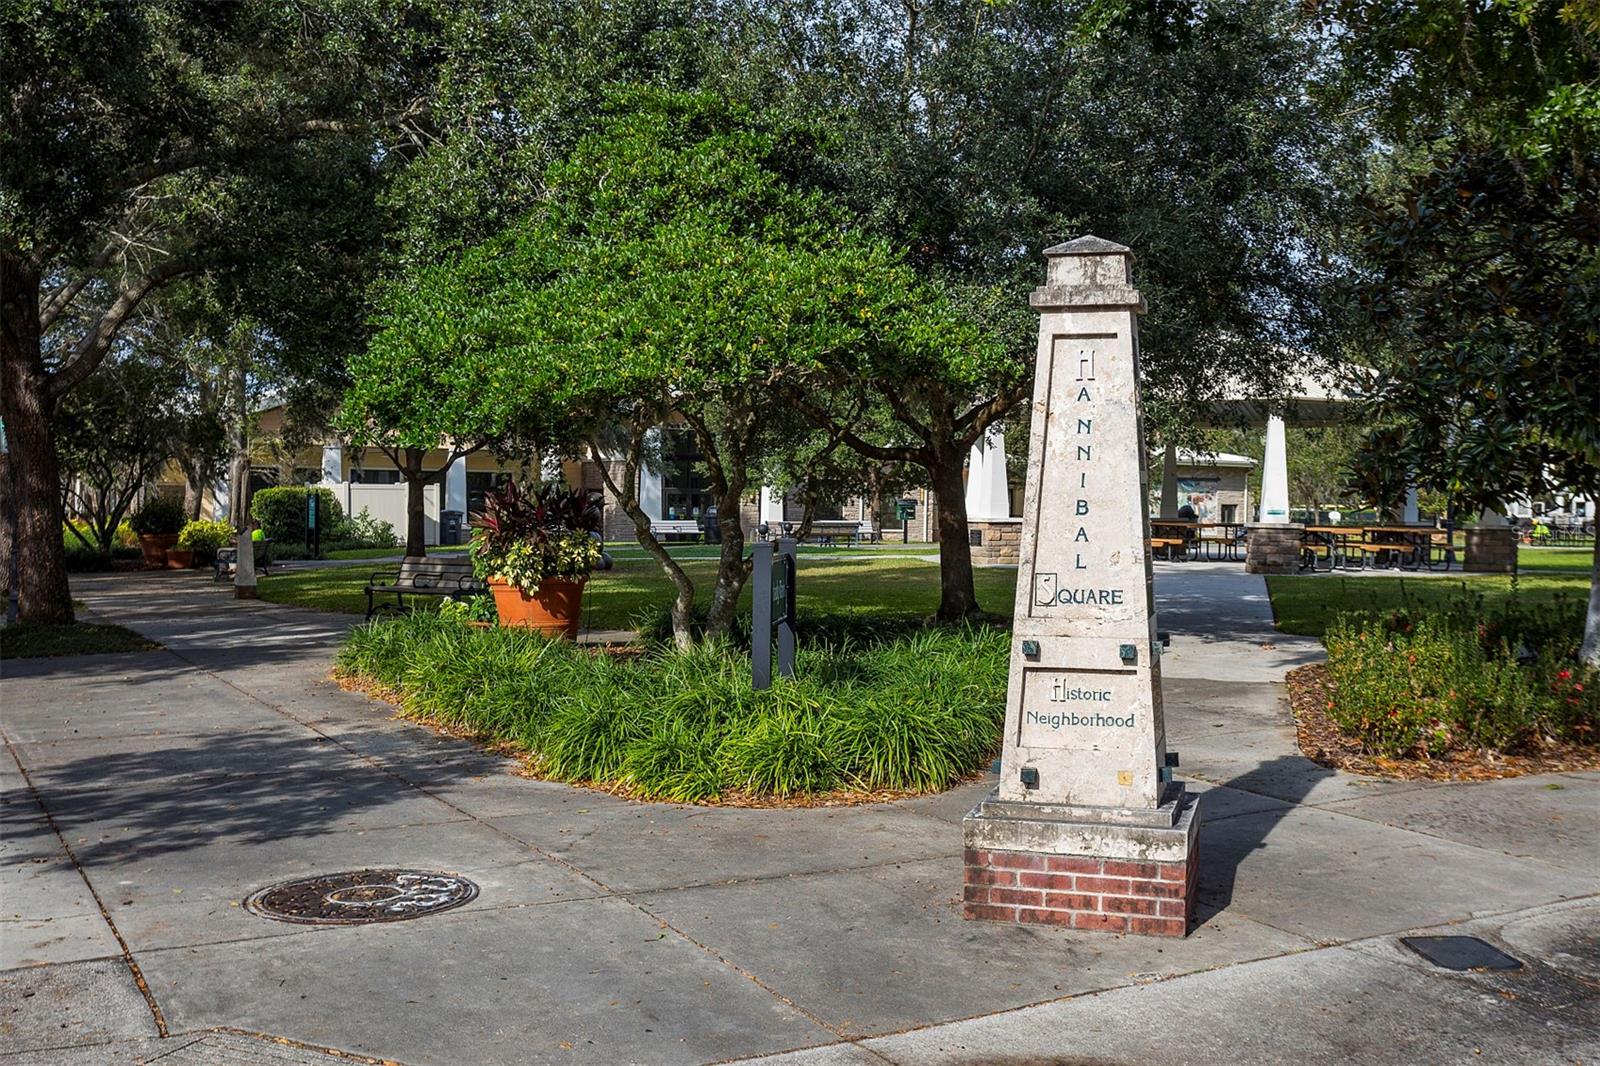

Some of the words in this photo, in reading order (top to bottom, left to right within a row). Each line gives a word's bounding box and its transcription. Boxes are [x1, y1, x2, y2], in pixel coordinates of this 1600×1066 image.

[1075, 350, 1096, 570] HANNIBAL
[1035, 573, 1124, 606] SQUARE
[1050, 678, 1112, 702] Historic
[1026, 711, 1135, 730] Neighborhood
